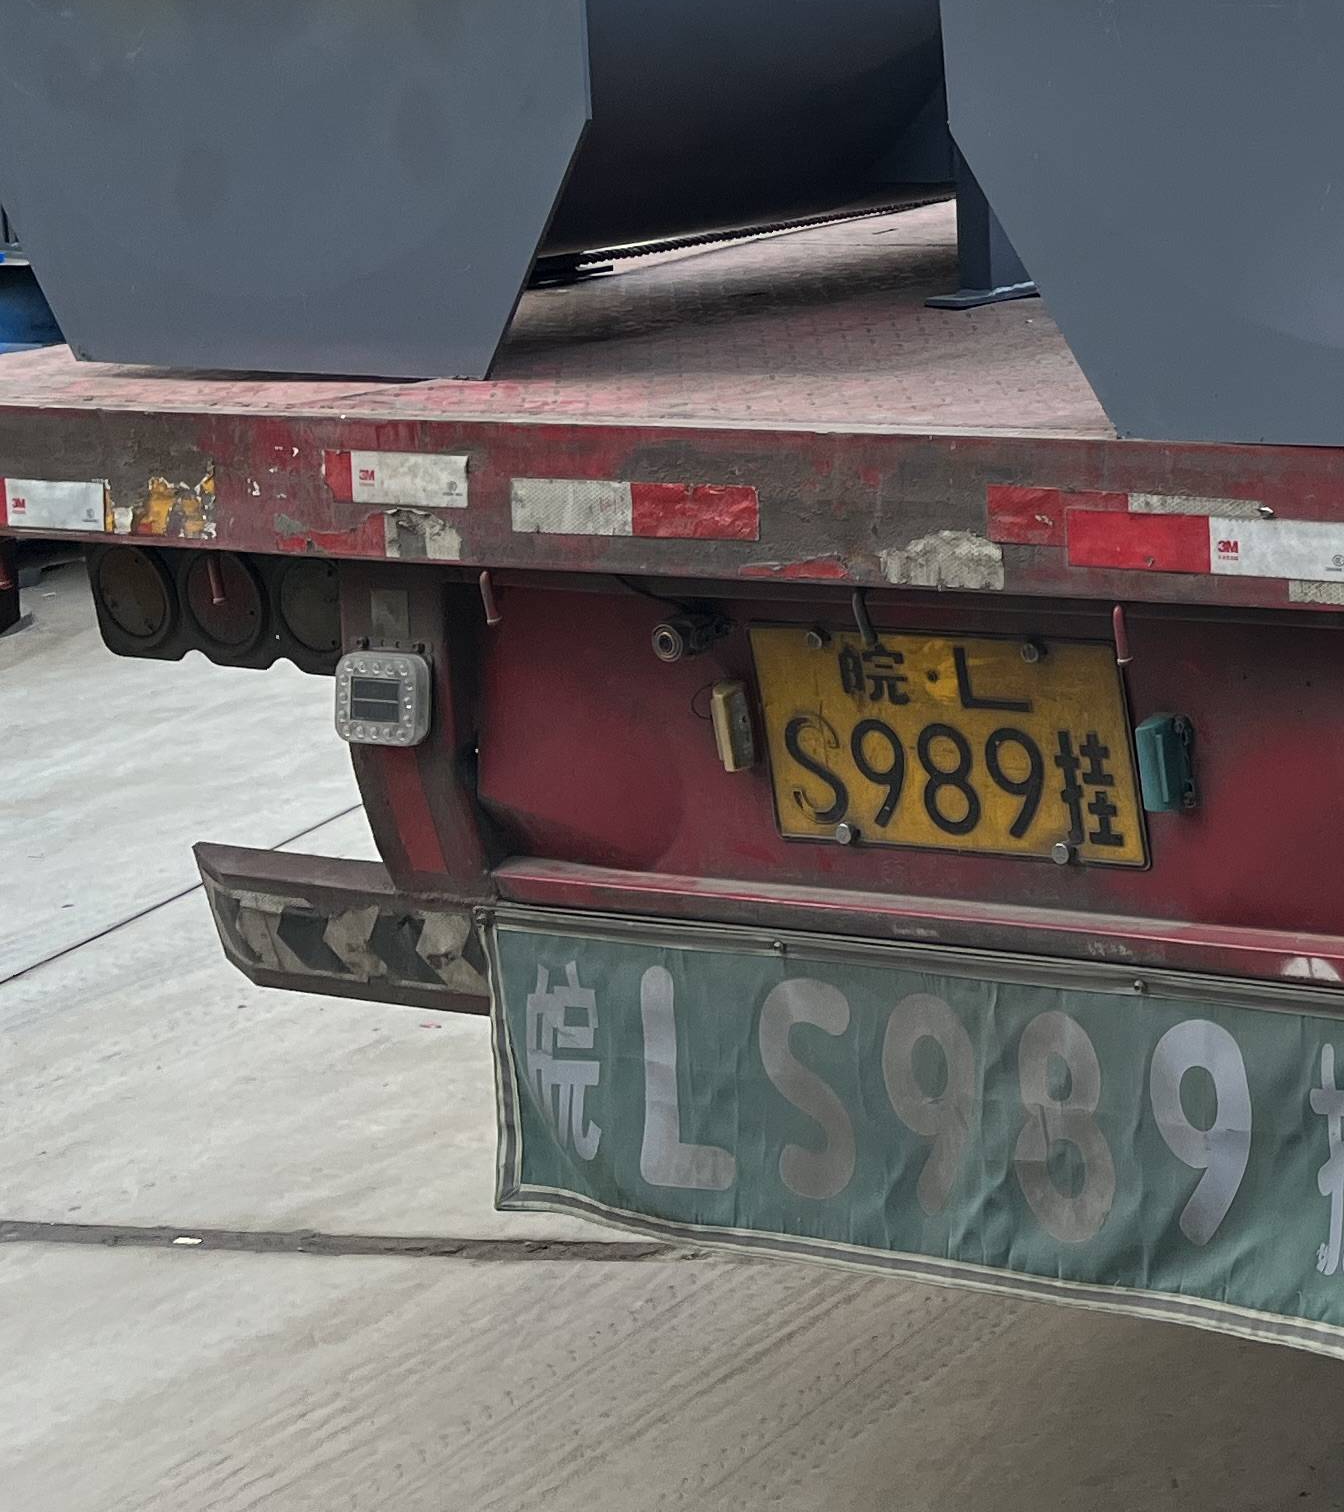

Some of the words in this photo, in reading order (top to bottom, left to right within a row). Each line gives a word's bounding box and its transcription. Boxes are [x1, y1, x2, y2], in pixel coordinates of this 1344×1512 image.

[359, 470, 375, 481] 3M
[1217, 540, 1239, 553] 3M
[784, 712, 1126, 847] S989挂
